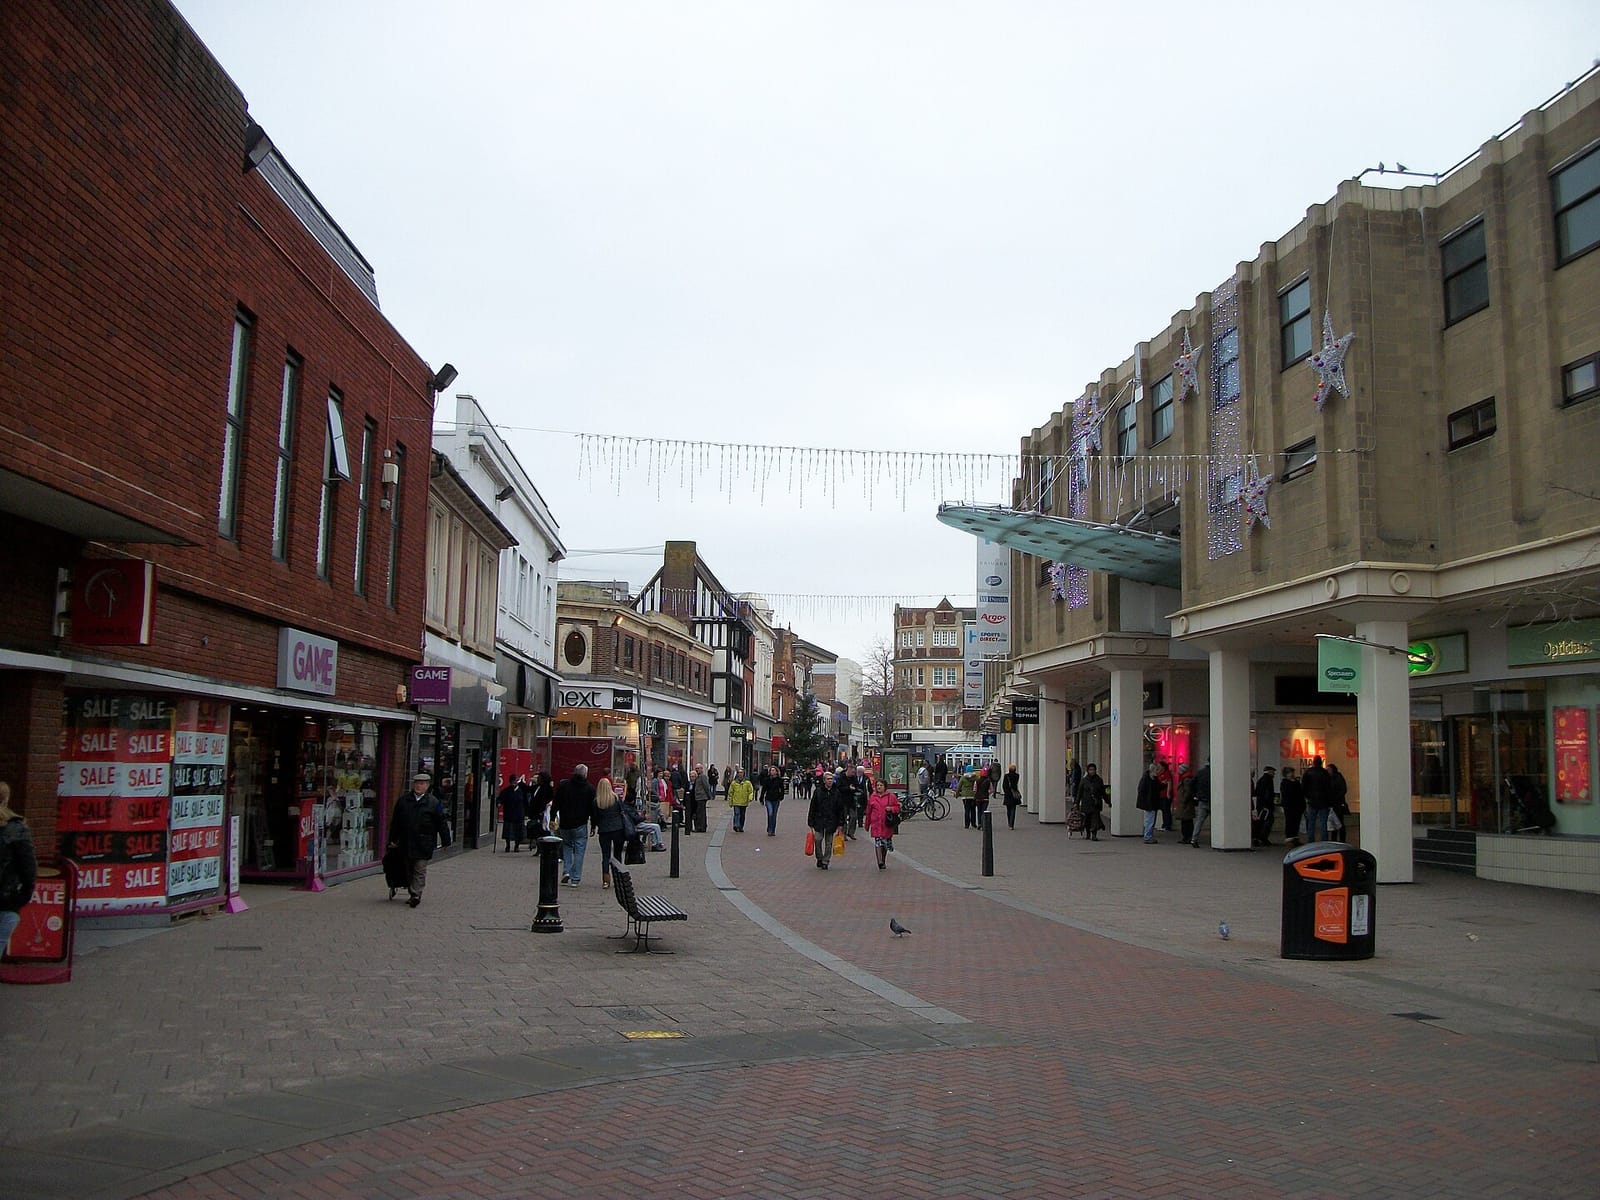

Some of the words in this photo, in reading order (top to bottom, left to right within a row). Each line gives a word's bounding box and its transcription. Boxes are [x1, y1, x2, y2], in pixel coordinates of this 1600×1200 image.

[980, 613, 1006, 622] Argos
[293, 641, 334, 686] GAME
[414, 669, 448, 680] GAME
[83, 698, 119, 718] SALE
[130, 701, 166, 721] SALE
[614, 695, 632, 703] next
[81, 733, 118, 752] SALE
[128, 734, 165, 754] SALE
[177, 736, 192, 754] SALE
[195, 737, 209, 754] SALE
[211, 738, 224, 755] SALE
[1280, 738, 1328, 759] SALE
[80, 766, 116, 786] SALE
[128, 767, 163, 787] SALE
[175, 767, 191, 788] SALE
[193, 767, 207, 787] SALE
[209, 768, 223, 787] SALE
[78, 799, 112, 819] SALE
[128, 800, 161, 819] SALE
[174, 800, 189, 819] SALE
[191, 799, 204, 819] SALE
[207, 799, 221, 817] SALE
[75, 833, 112, 854] SALE
[126, 833, 161, 854] SALE
[172, 832, 188, 853] SALE
[188, 831, 204, 851] SALE
[205, 829, 219, 849] SALE
[77, 867, 112, 889] SALE
[125, 867, 161, 889] SALE
[171, 864, 186, 886] SALE
[186, 862, 201, 884] SALE
[203, 862, 218, 882] SALE
[29, 891, 65, 904] ALE
